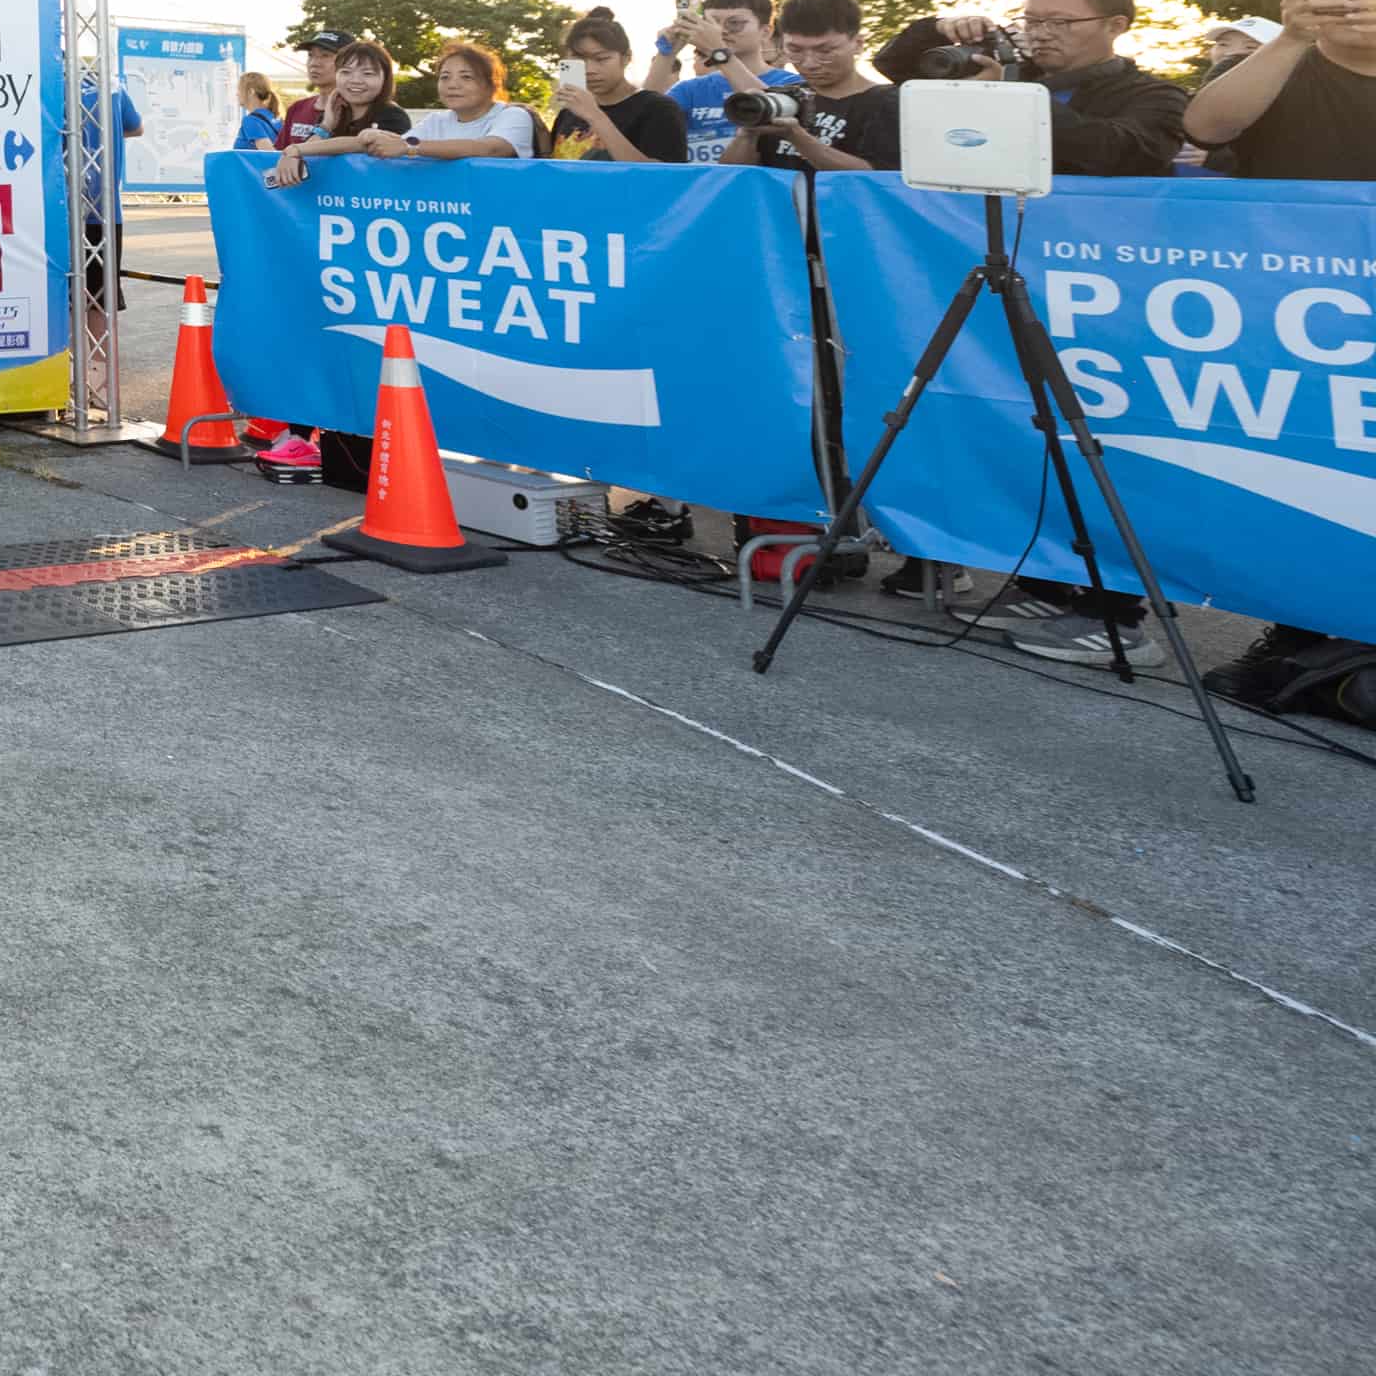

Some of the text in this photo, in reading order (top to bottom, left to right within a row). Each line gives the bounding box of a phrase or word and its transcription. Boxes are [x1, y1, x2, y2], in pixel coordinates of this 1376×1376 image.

[317, 195, 472, 216] ION SUPPLY DRINK
[319, 214, 626, 288] POCARI
[1043, 240, 1376, 278] ION SUPPLY DRINK
[320, 266, 596, 345] SWEAT
[1045, 269, 1376, 366] POC
